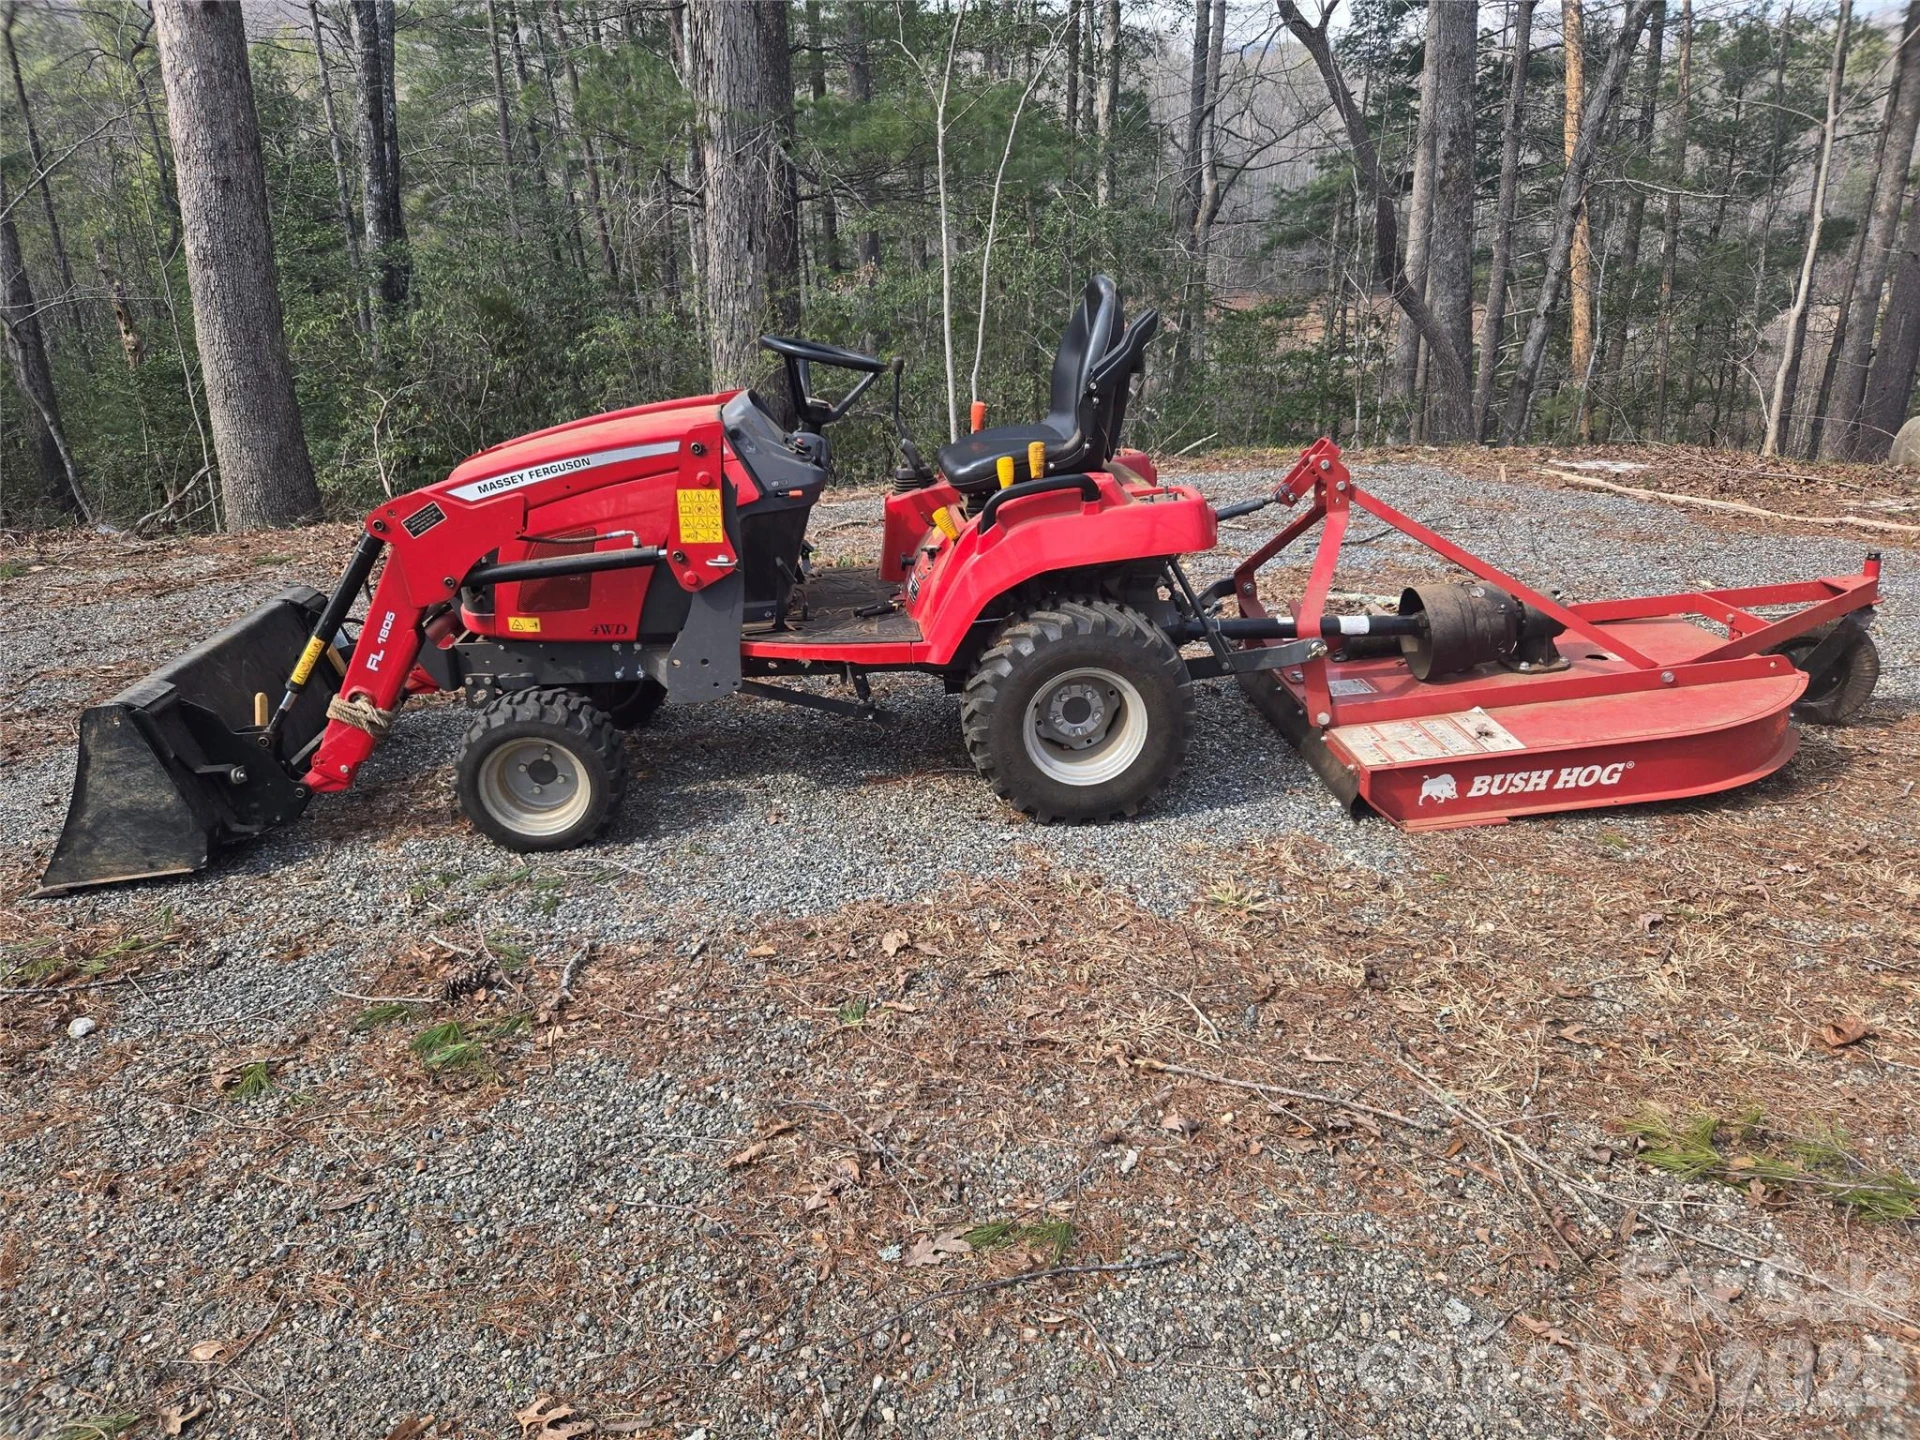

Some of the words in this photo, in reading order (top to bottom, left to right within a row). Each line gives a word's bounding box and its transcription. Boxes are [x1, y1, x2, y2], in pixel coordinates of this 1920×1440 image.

[477, 474, 525, 494] MASSEY
[528, 457, 591, 480] FERGUSON
[366, 650, 385, 672] FL
[377, 610, 396, 644] 1805
[590, 623, 629, 635] 4WD
[1466, 769, 1554, 798] BUSH
